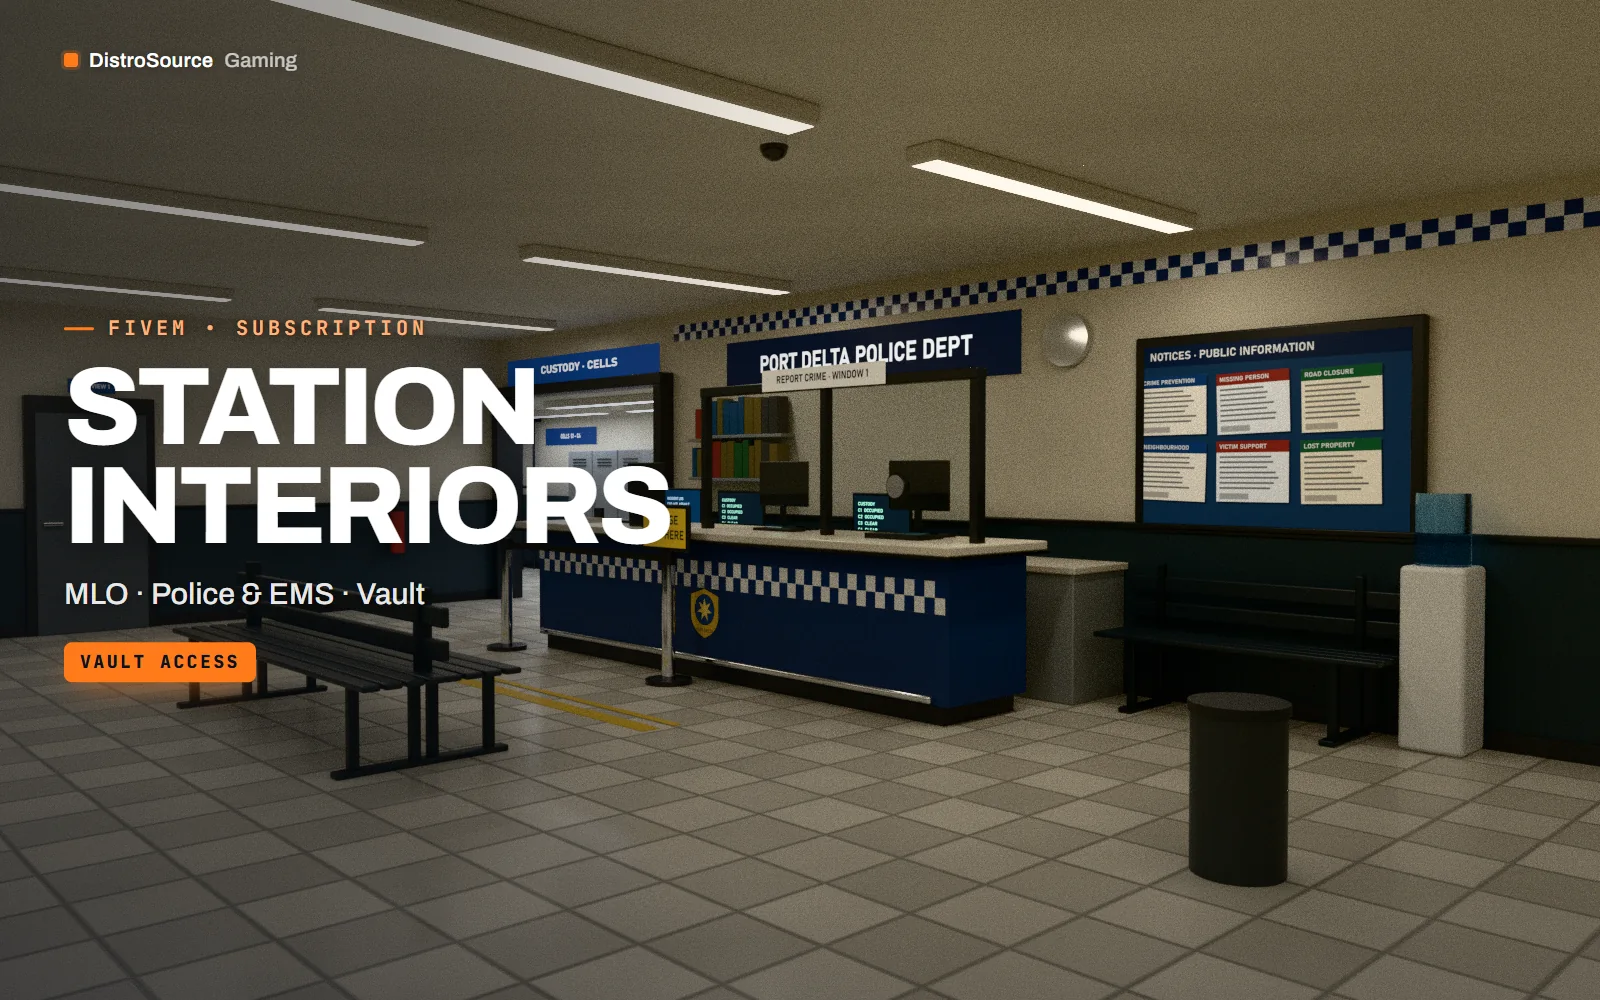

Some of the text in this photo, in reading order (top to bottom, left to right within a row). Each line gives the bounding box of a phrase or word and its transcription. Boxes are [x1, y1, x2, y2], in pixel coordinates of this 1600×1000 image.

[760, 334, 974, 373] PORT DELTA POLICE DEPT
[1150, 341, 1316, 362] NOTICES PUBLIC INFORMATION
[540, 357, 618, 375] CUSTODY CELLS
[1324, 368, 1354, 376] CLOSURE
[776, 368, 870, 384] REPORT CRIME WINDOW 1
[1160, 378, 1196, 386] PREVENTION
[1219, 375, 1243, 383] MISSING
[1320, 441, 1356, 449] PROPERTY
